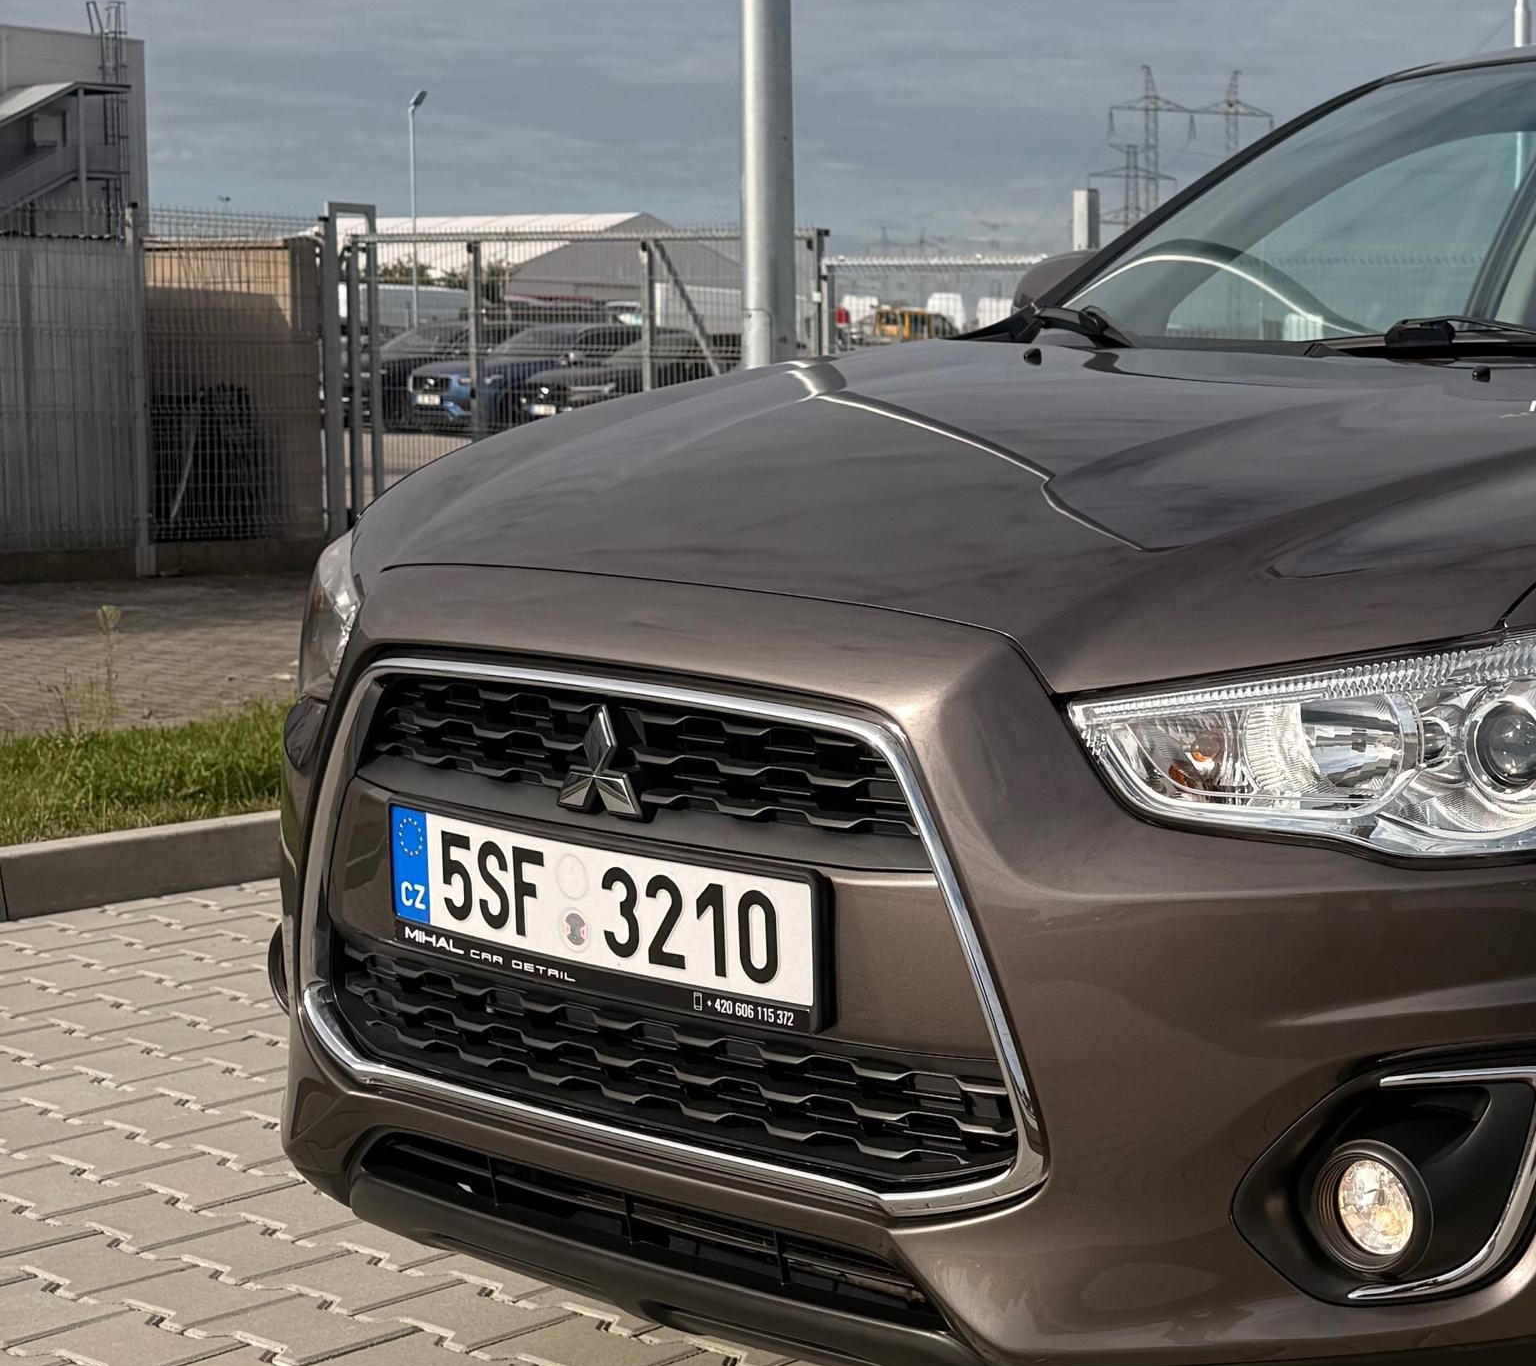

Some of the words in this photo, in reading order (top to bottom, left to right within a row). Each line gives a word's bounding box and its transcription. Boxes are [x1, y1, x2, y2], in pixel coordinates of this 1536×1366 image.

[400, 881, 427, 911] CZ
[441, 830, 545, 938] 5SF
[601, 866, 779, 985] 3210
[404, 925, 465, 955] MIHAL
[469, 949, 504, 966] CAR
[511, 959, 577, 983] DETAIL
[714, 997, 733, 1015] 420
[735, 1002, 755, 1019] 606
[757, 1006, 775, 1023] 115
[776, 1010, 795, 1027] 372
